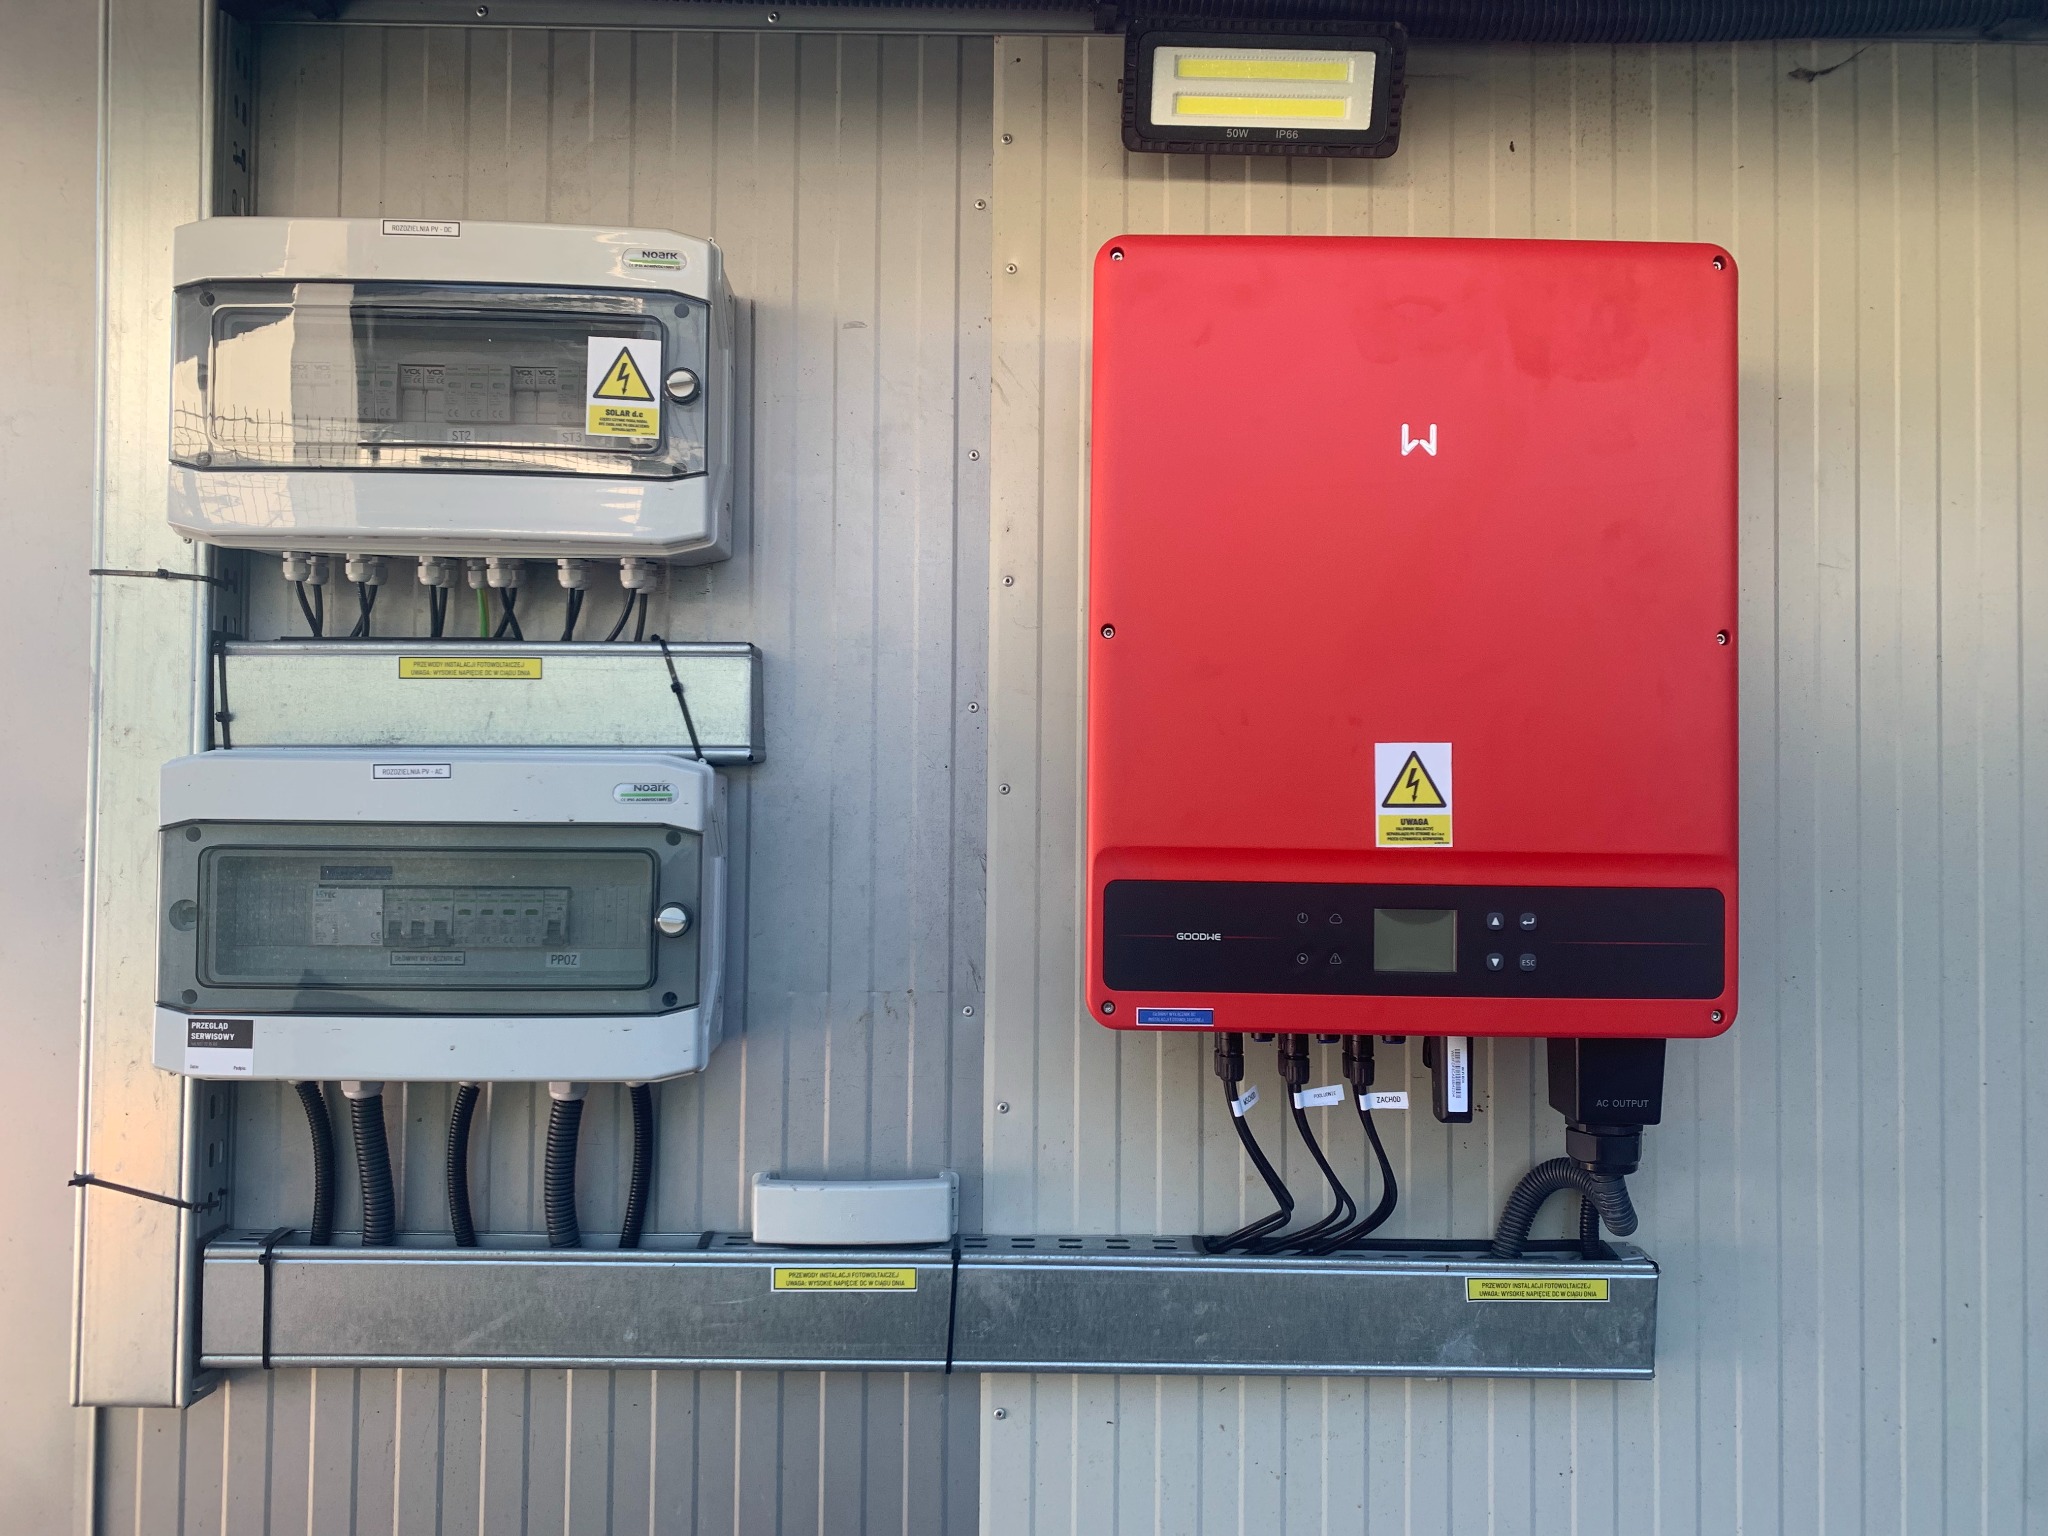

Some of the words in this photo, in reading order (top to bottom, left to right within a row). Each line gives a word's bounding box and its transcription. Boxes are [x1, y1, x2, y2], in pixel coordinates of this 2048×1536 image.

[1226, 129, 1249, 138] 50W
[1276, 130, 1299, 139] IP66
[392, 224, 430, 232] ROZDZIELNIA
[605, 409, 630, 417] SOLAR
[452, 430, 471, 441] ST2
[562, 432, 582, 442] ST3
[1176, 933, 1221, 941] GOODWE
[1522, 959, 1535, 967] ESC
[191, 1022, 228, 1031] PRZEGLĄD
[1596, 1099, 1609, 1107] AC
[1612, 1099, 1650, 1108] OUTPUT
